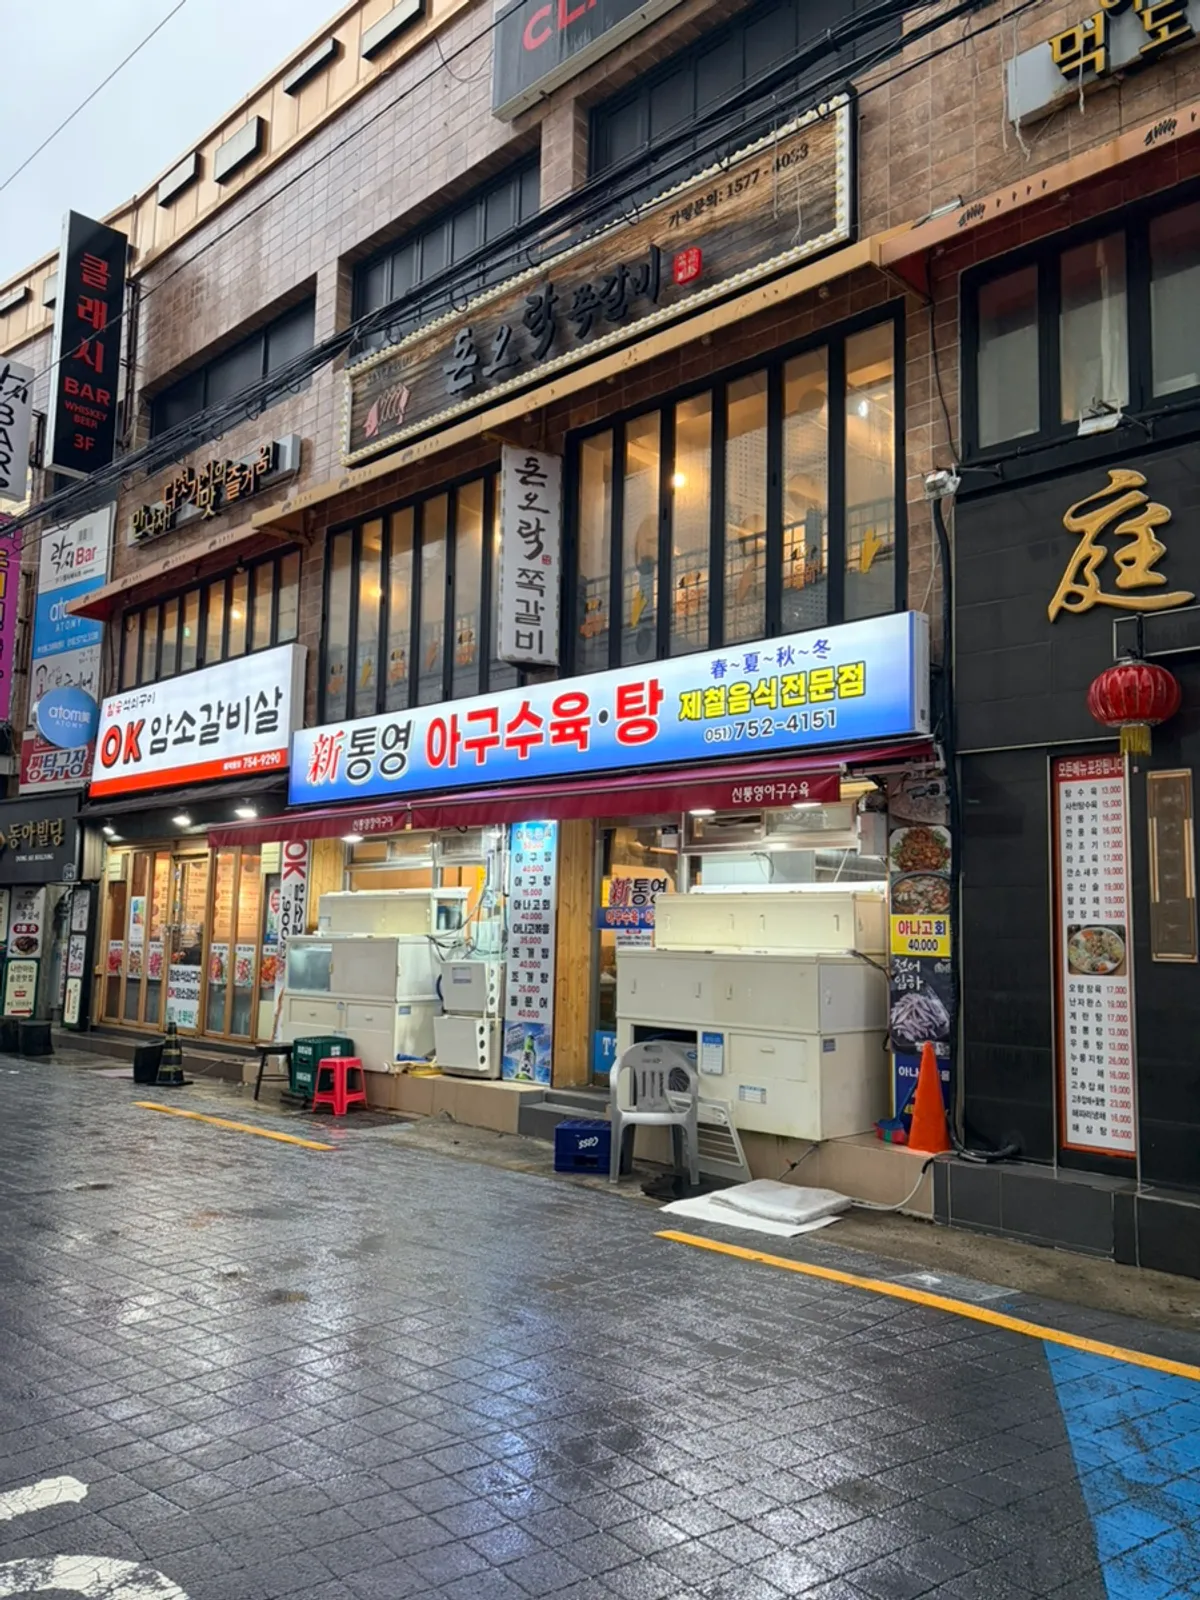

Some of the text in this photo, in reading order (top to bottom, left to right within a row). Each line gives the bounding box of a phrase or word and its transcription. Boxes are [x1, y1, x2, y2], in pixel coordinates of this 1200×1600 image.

[727, 168, 760, 198] 1577
[72, 253, 111, 374] 클래시
[64, 376, 111, 407] BAR
[64, 400, 107, 422] WHISKEY
[73, 413, 98, 430] BEER
[73, 433, 95, 451] 3F
[75, 545, 97, 566] Bar
[514, 567, 546, 654] 쪽갈비
[101, 686, 283, 769] OK 암소갈비살
[242, 752, 281, 770] 754-9290
[307, 719, 414, 785] 新통영
[731, 781, 810, 803] 신통영아구수육
[8, 818, 63, 849] 동아빌딩
[283, 840, 308, 880] OK
[513, 900, 551, 910] 아나고회
[894, 974, 924, 990] 입하
